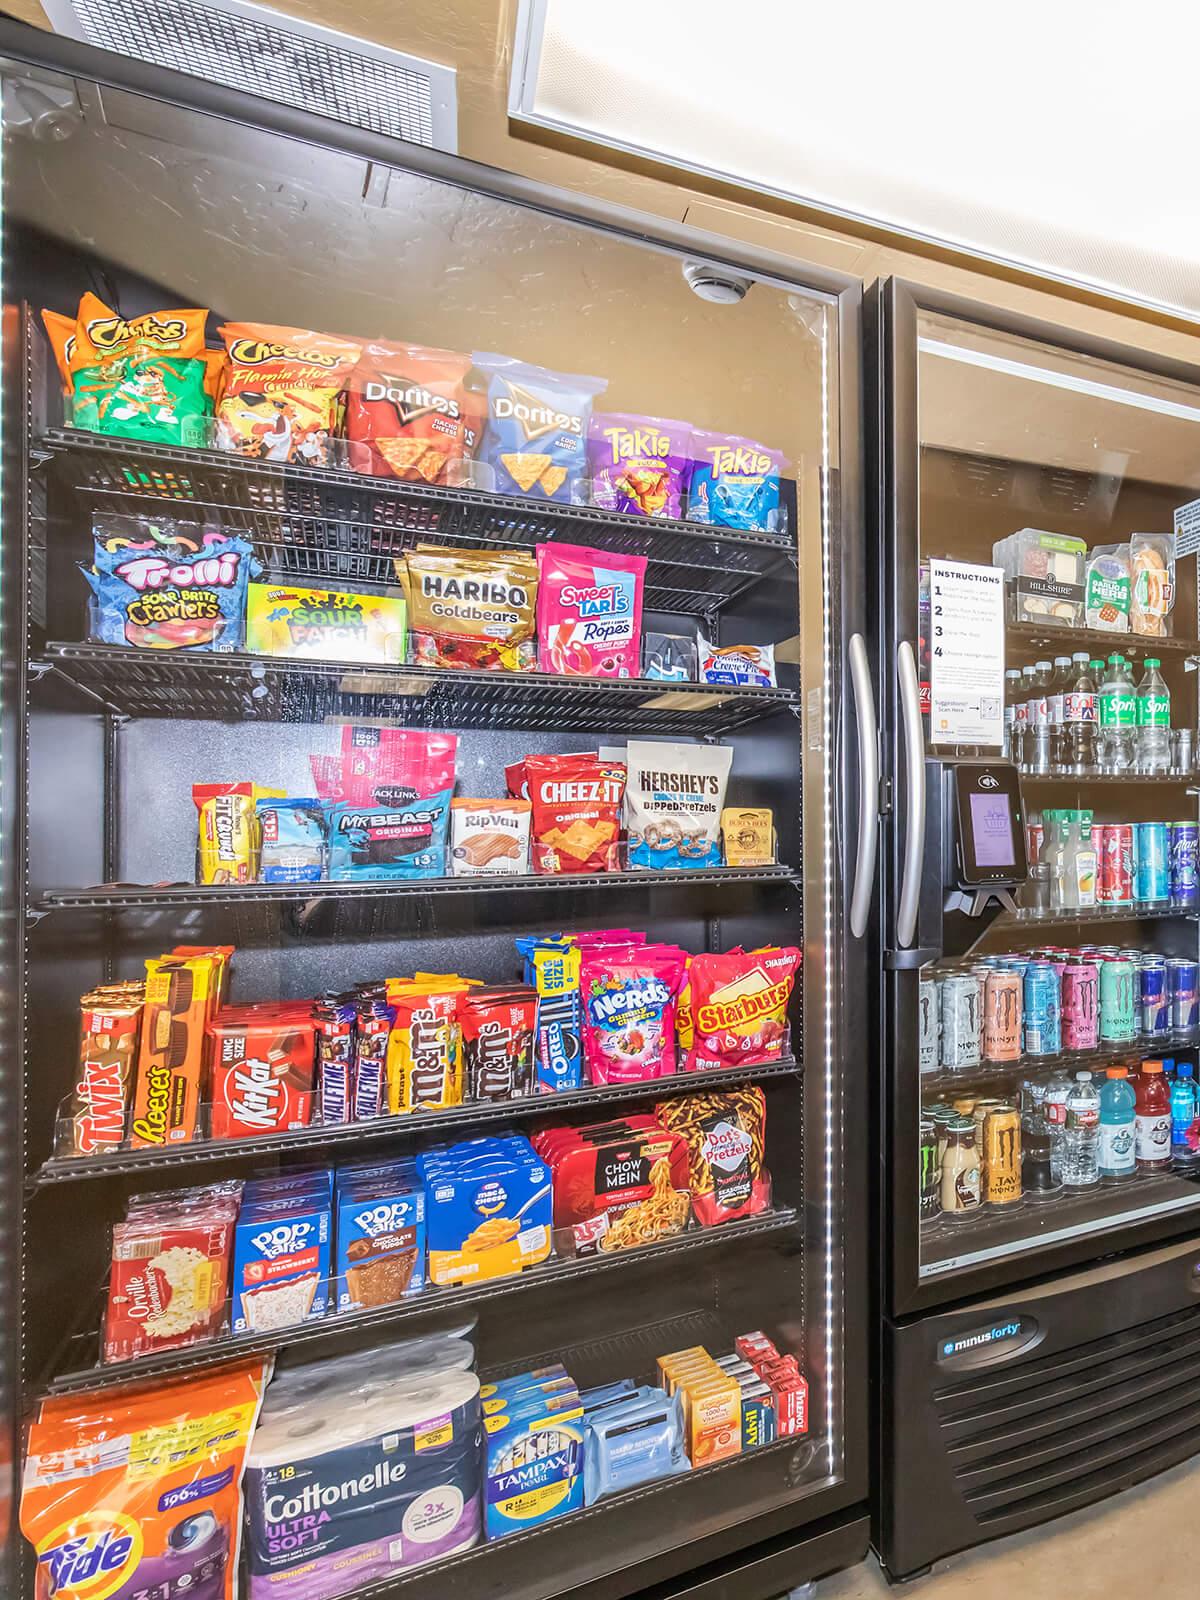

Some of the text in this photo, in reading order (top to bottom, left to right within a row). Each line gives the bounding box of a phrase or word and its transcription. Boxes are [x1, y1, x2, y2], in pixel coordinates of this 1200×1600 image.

[231, 339, 342, 368] Cheetos
[366, 382, 460, 418] Doritos
[495, 398, 582, 433] Doritos
[602, 427, 671, 465] Takis
[706, 445, 772, 479] Takis
[115, 552, 241, 589] Trolli
[934, 569, 1001, 585] INSTRUCTIONS
[180, 589, 219, 604] BRITE
[422, 575, 528, 609] HARIBO
[934, 585, 942, 596] 1
[1029, 580, 1073, 596] HILLSHIRE
[127, 600, 221, 626] Crawlers
[291, 608, 362, 628] SOUR
[431, 602, 519, 624] Goldbears
[934, 605, 943, 616] 2
[583, 623, 630, 641] Ropes
[935, 625, 943, 637] 3
[934, 646, 943, 657] 4
[640, 770, 720, 796] HERSHEY'S
[375, 826, 425, 836] ORIGINAL
[464, 814, 519, 831] Rip Van
[543, 959, 554, 991] KING
[553, 958, 564, 989] SIZE
[607, 1006, 648, 1023] Gummy
[222, 1037, 234, 1063] KING
[234, 1036, 246, 1059] SIZE
[548, 1021, 568, 1076] OREO
[322, 1061, 346, 1122] HALFTIME
[355, 1057, 382, 1118] HALFTIME
[397, 1067, 406, 1108] peanut
[708, 1127, 741, 1147] Dot's
[704, 1142, 751, 1164] Pretzels
[604, 1159, 642, 1176] CHOW
[606, 1171, 641, 1189] MEIN
[477, 1189, 497, 1199] mac
[125, 1275, 151, 1319] Orville
[339, 1292, 351, 1305] 8
[234, 1317, 246, 1331] 8
[953, 1320, 1020, 1352] minusforty
[702, 1412, 725, 1424] Vitamin
[795, 1388, 807, 1431] TYLENOL
[745, 1408, 758, 1447] Advil
[278, 1466, 296, 1480] 18
[494, 1452, 567, 1492] TAMPAX
[263, 1460, 407, 1523] Cottonelle
[423, 1502, 446, 1518] 3x
[505, 1503, 514, 1513] R
[266, 1509, 333, 1540] ULTRA
[267, 1526, 322, 1554] SOFT
[39, 1528, 135, 1597] Tide
